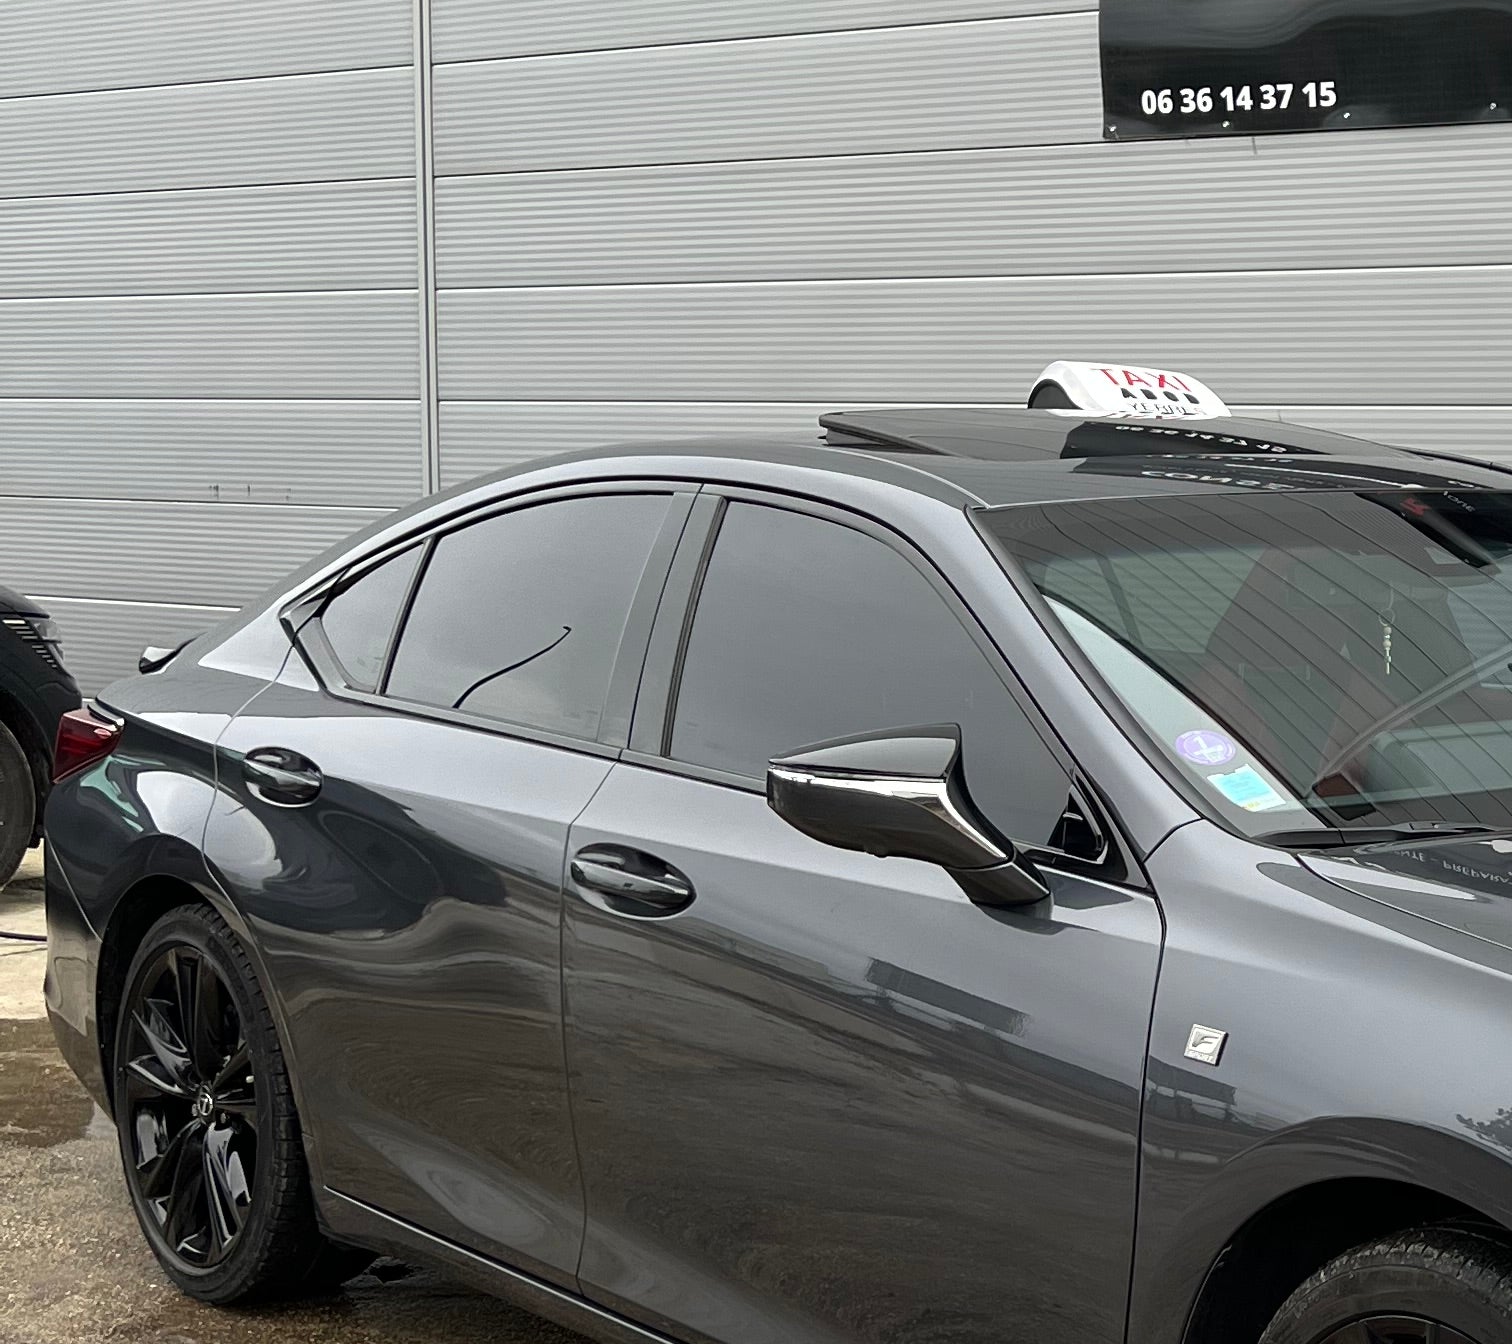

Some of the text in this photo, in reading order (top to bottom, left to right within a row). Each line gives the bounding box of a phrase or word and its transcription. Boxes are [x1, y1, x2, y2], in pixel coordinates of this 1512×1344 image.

[1141, 81, 1337, 115] 06 36 14 37 15
[1090, 368, 1192, 392] TAXI
